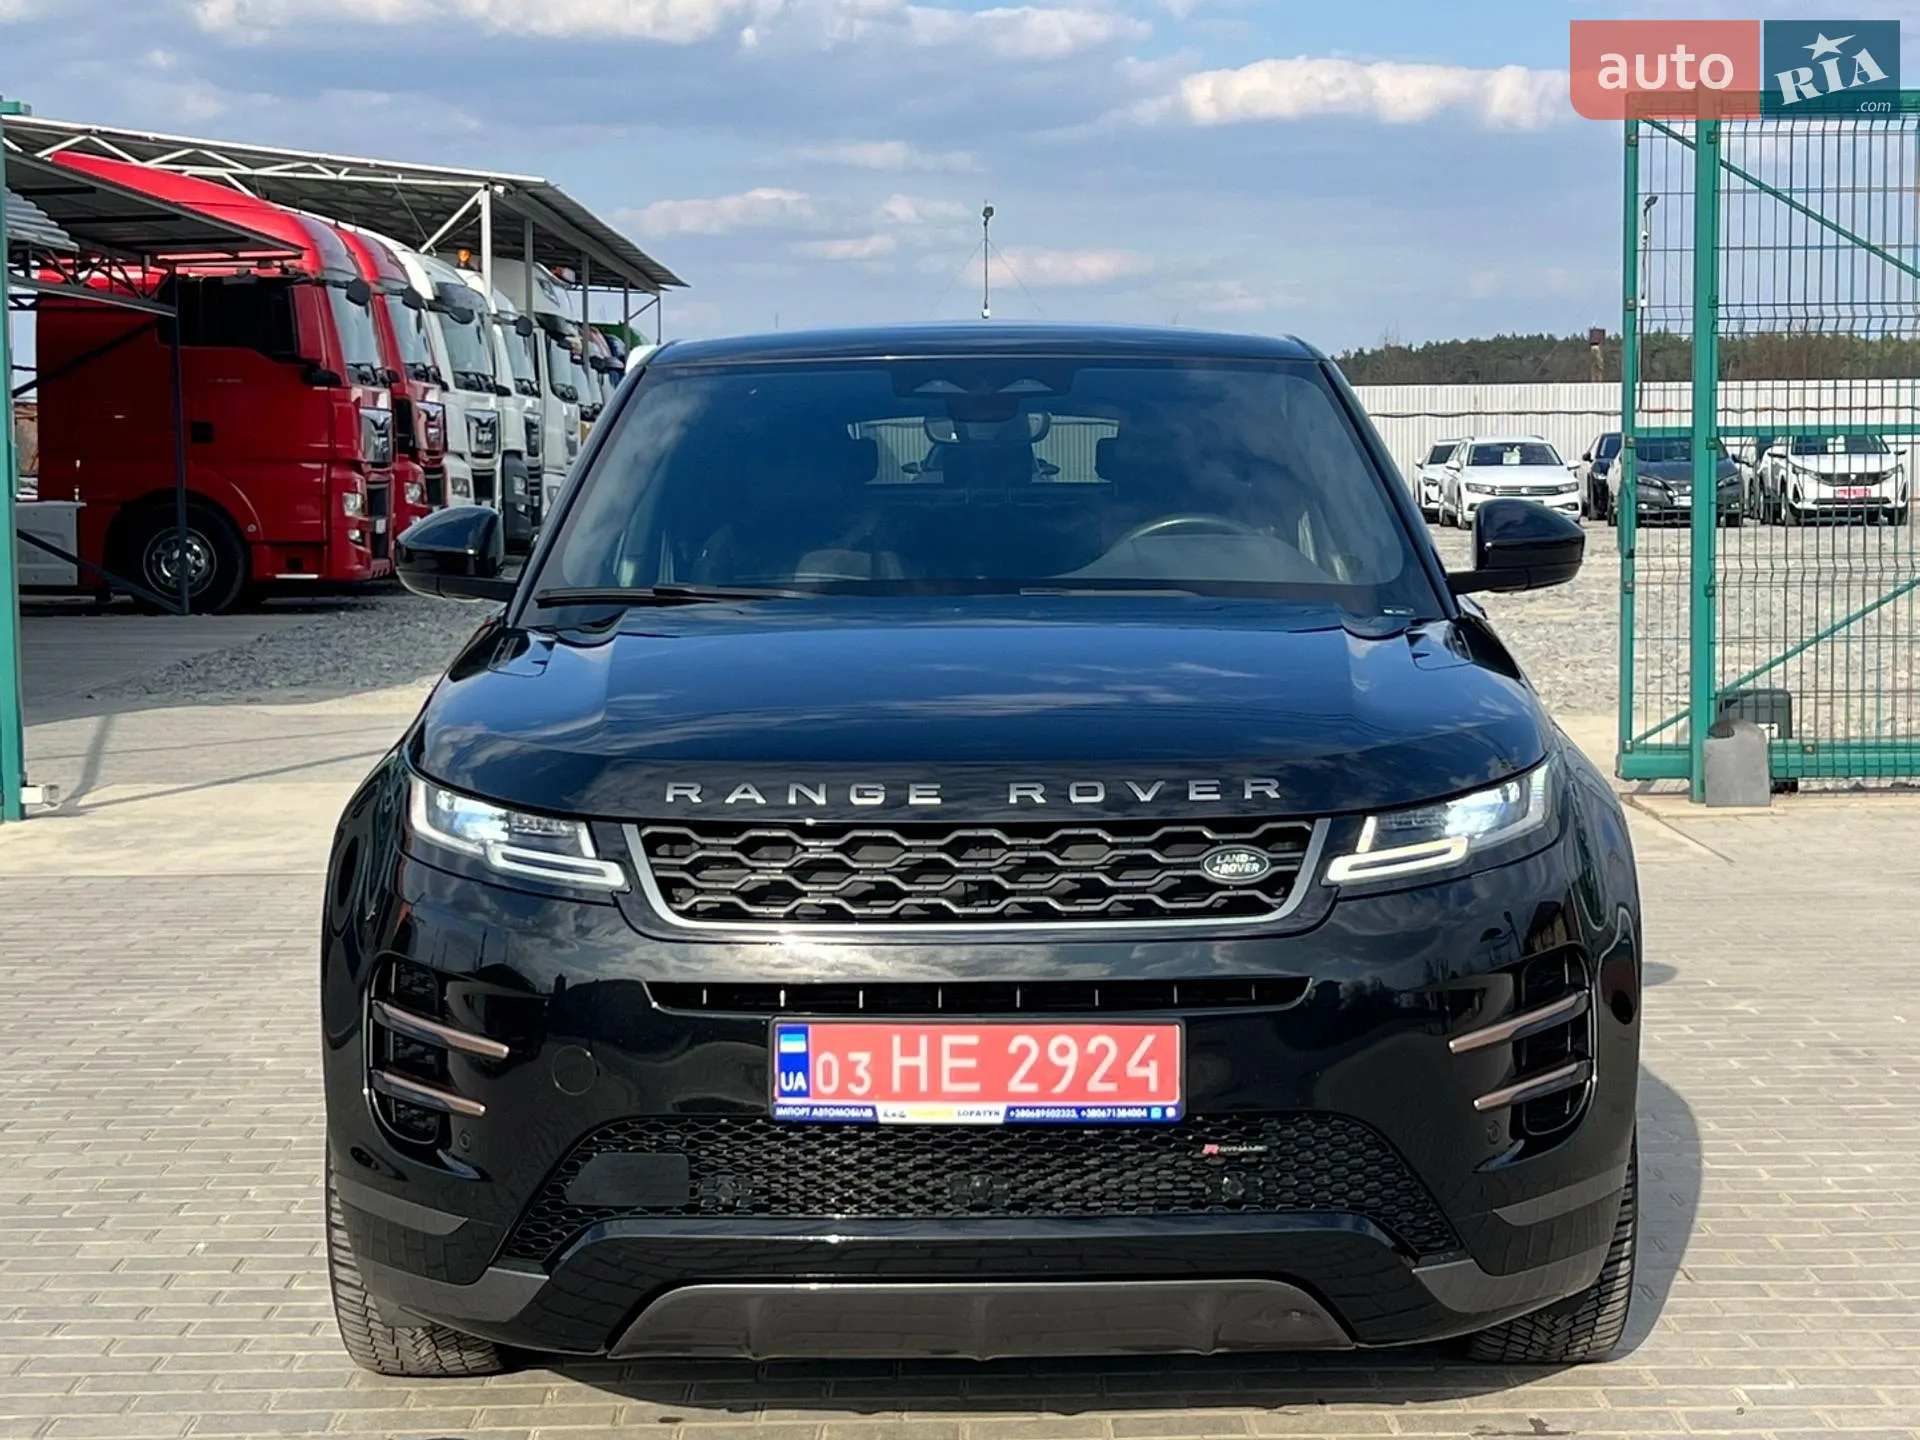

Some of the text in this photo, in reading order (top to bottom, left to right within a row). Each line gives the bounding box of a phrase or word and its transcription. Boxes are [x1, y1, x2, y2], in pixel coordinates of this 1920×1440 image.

[664, 778, 1282, 805] RANGE ROVER
[1216, 853, 1249, 864] LAND
[1219, 862, 1260, 874] ROVER
[815, 1034, 1159, 1095] 03 HE 2924
[780, 1071, 807, 1092] UA
